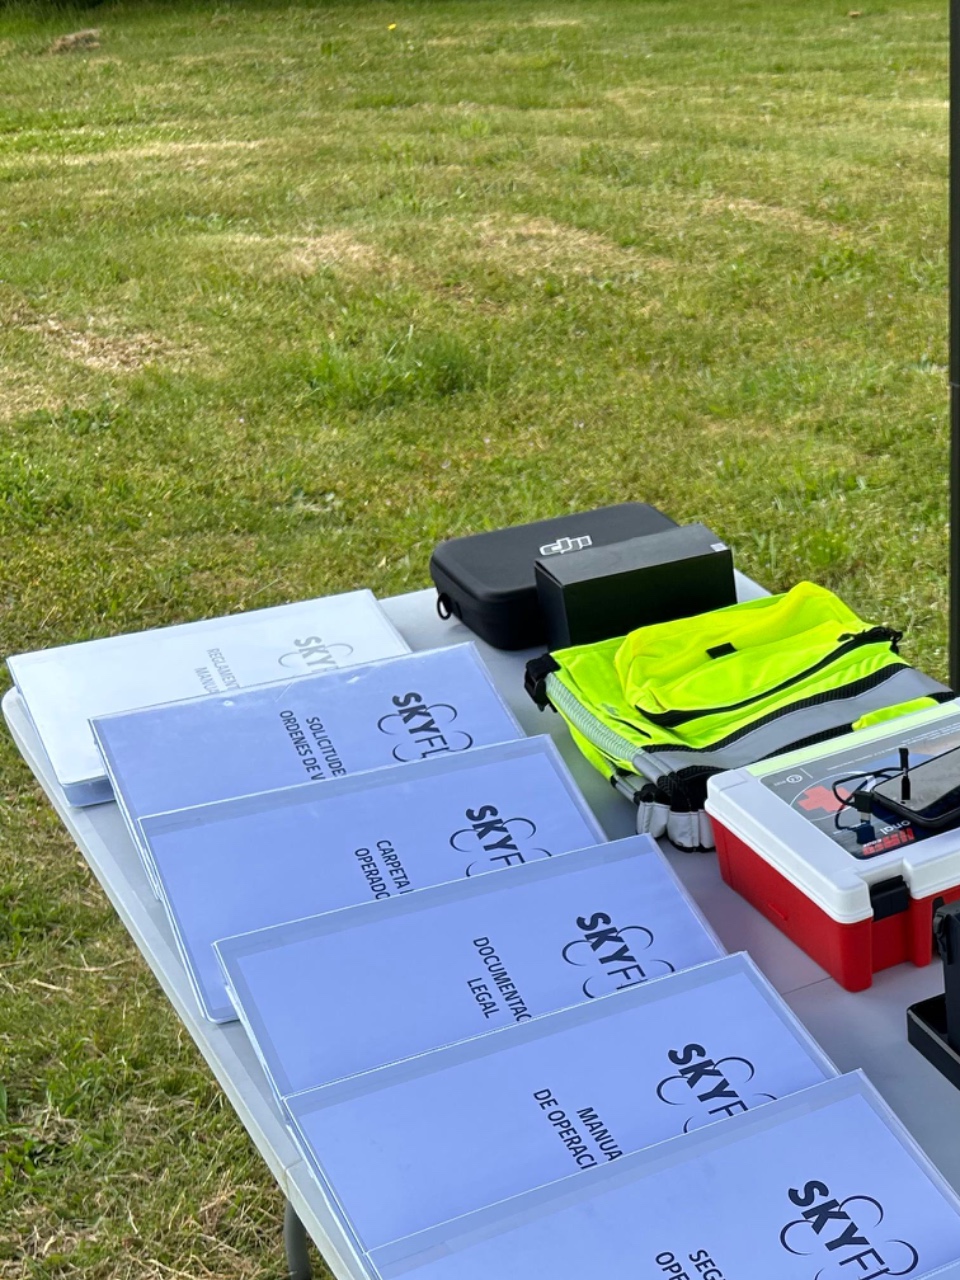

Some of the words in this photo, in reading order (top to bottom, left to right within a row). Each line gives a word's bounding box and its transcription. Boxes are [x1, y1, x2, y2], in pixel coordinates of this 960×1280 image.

[207, 647, 241, 690] REGLAMENT
[294, 635, 339, 673] SKY
[279, 709, 313, 757] ORDENES
[302, 756, 321, 773] DE
[306, 716, 347, 777] SOLICITUDE
[392, 692, 450, 759] SKYFL
[376, 839, 411, 889] CARPETA
[465, 804, 526, 866] SKYF
[466, 977, 500, 1019] LEGAL
[472, 936, 533, 1022] DOCUMENTAC
[667, 1043, 749, 1117] SKYF
[533, 1088, 559, 1111] DE
[547, 1107, 598, 1170] OPERACI
[577, 1106, 624, 1162] MANUA
